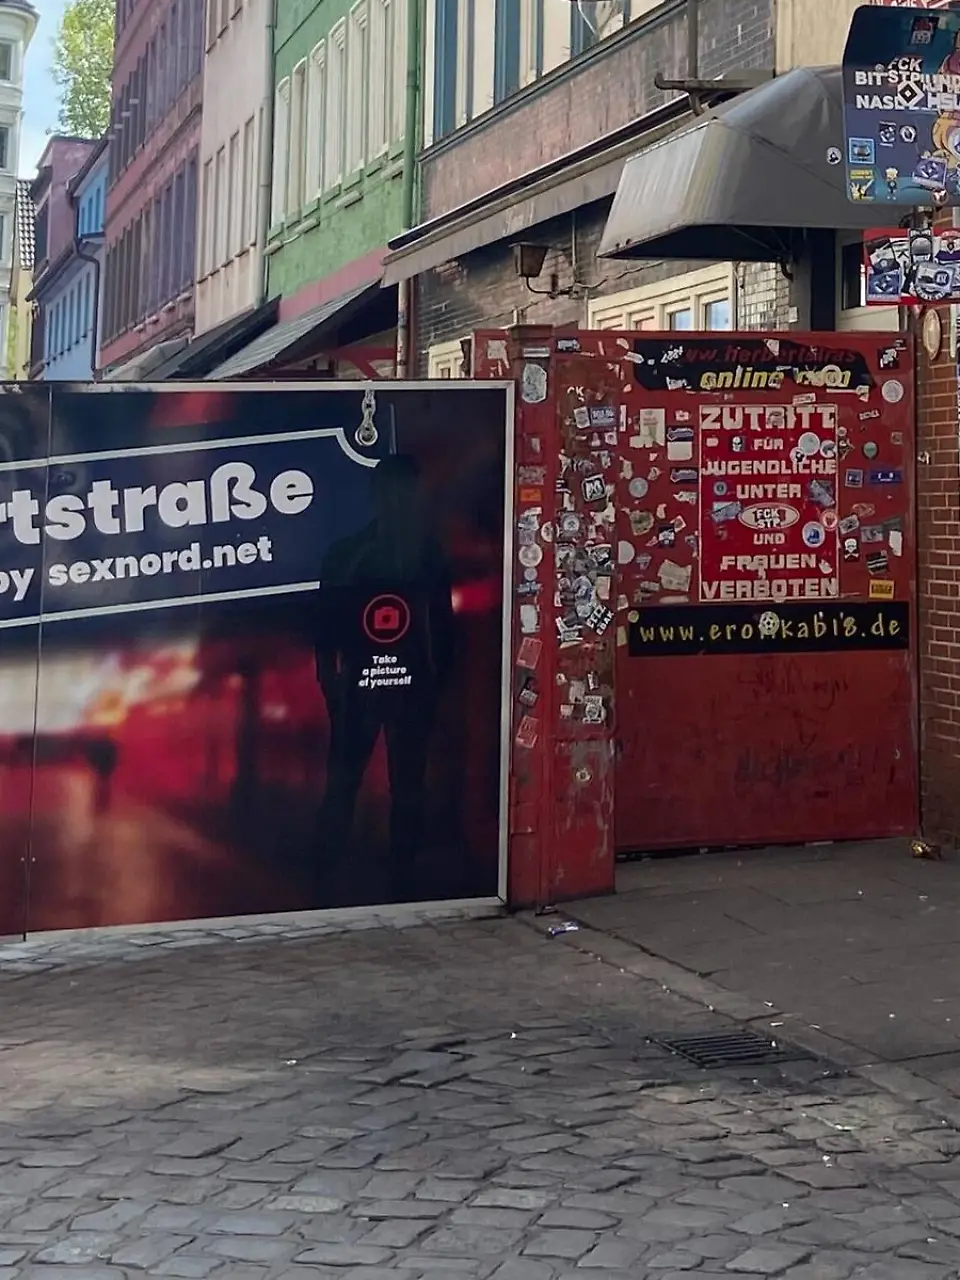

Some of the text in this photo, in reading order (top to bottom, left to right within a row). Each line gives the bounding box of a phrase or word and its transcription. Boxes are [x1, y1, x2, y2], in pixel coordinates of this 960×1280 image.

[701, 406, 836, 431] ZUTRITT
[753, 437, 784, 450] FÜR
[701, 460, 837, 476] JUGENDLICHE
[736, 483, 802, 499] UNTER
[0, 461, 314, 545] tstraße
[753, 533, 786, 545] UND
[48, 536, 273, 587] sexnord.net
[720, 553, 817, 570] FRAUEN
[702, 577, 839, 599] VERBOTEN
[372, 654, 398, 664] Take
[370, 665, 407, 677] picture
[358, 675, 412, 689] of yourself
